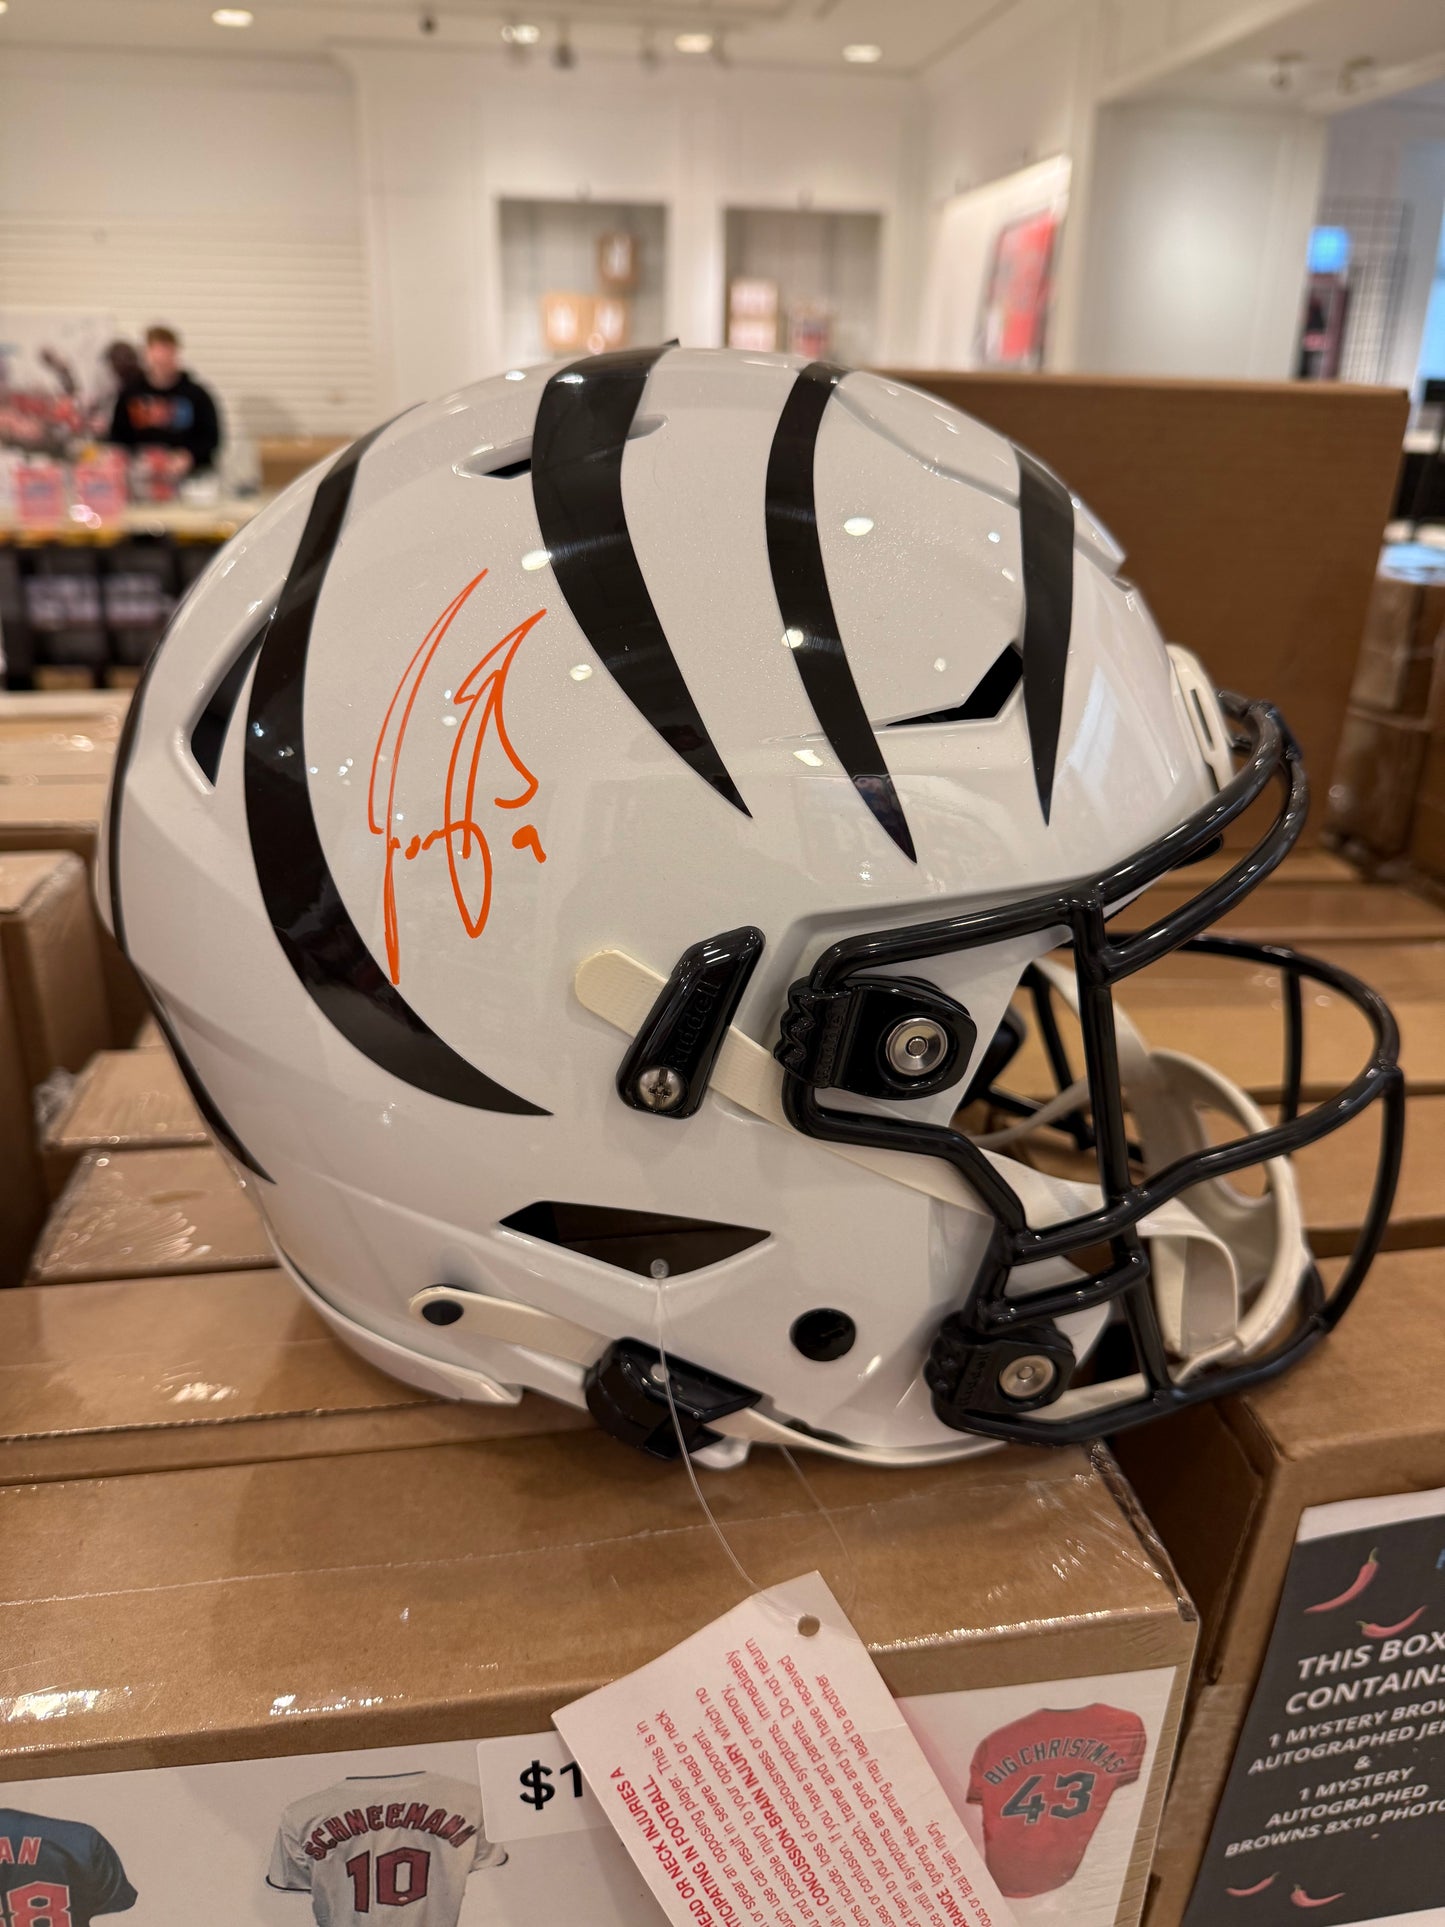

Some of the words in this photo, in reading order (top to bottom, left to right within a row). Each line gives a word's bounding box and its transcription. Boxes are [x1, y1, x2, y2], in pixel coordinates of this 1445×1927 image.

[745, 1638, 771, 1676] return
[1298, 1644, 1373, 1682] THIS
[1378, 1631, 1445, 1663] BOX
[695, 1687, 711, 1705] no
[726, 1649, 771, 1721] immediately
[764, 1674, 783, 1698] not
[777, 1655, 814, 1707] received
[815, 1674, 847, 1719] another
[704, 1704, 731, 1741] which
[721, 1684, 754, 1736] memory,
[778, 1697, 795, 1719] Do
[809, 1706, 831, 1738] have
[636, 1720, 650, 1736] in
[644, 1733, 657, 1747] is
[655, 1709, 680, 1740] neck
[791, 1716, 825, 1764] parents.
[842, 1719, 855, 1735] to
[1269, 1733, 1281, 1748] 1
[1286, 1710, 1388, 1745] MYSTERY
[673, 1740, 688, 1755] or
[692, 1726, 733, 1785] opponent.
[748, 1737, 763, 1750] or
[768, 1720, 808, 1783] symptoms,
[826, 1736, 848, 1759] you
[847, 1733, 869, 1760] lead
[1248, 1726, 1415, 1775] AUTOGRAPHED
[609, 1766, 625, 1779] A
[651, 1746, 672, 1776] This
[679, 1754, 706, 1788] head
[723, 1742, 760, 1790] INJURY
[813, 1762, 836, 1786] and
[836, 1758, 858, 1781] and
[865, 1758, 884, 1784] may
[983, 1756, 1019, 1785] BIG
[1018, 1737, 1125, 1775] CHRISTMAS
[1354, 1755, 1372, 1771] &
[667, 1772, 700, 1812] player.
[726, 1785, 752, 1812] your
[758, 1749, 811, 1830] consciousness
[802, 1782, 824, 1813] have
[852, 1780, 877, 1810] gone
[1001, 1770, 1096, 1825] 43
[1299, 1788, 1310, 1801] 1
[1315, 1766, 1415, 1798] MYSTERY
[616, 1779, 661, 1842] INJURIES
[642, 1774, 691, 1848] FOOTBALL.
[700, 1784, 729, 1823] severe
[742, 1810, 756, 1826] to
[829, 1786, 856, 1823] trainer
[868, 1809, 886, 1829] are
[878, 1781, 908, 1827] warning
[1265, 1784, 1429, 1828] AUTOGRAPHED
[304, 1802, 477, 1861] SCHNEEMANN
[690, 1809, 728, 1864] opposing
[723, 1822, 736, 1835] in
[801, 1830, 818, 1843] of
[819, 1809, 841, 1833] you
[925, 1820, 947, 1851] injury.
[1225, 1824, 1321, 1857] BROWNS
[1324, 1814, 1377, 1834] 8X10
[728, 1833, 755, 1867] result
[750, 1824, 775, 1858] injury
[750, 1786, 830, 1907] CONCUSSION-BRAIN
[827, 1832, 843, 1844] If
[851, 1820, 877, 1858] coach,
[903, 1826, 920, 1848] this
[652, 1838, 684, 1880] NECK
[681, 1844, 700, 1864] IN
[812, 1842, 832, 1868] loss
[838, 1841, 874, 1894] confusion.
[871, 1857, 894, 1882] your
[879, 1828, 916, 1881] symptoms
[914, 1844, 945, 1888] Ignoring
[941, 1850, 962, 1878] brain
[345, 1846, 431, 1913] 10
[722, 1863, 738, 1880] an
[749, 1865, 768, 1888] can
[769, 1854, 805, 1900] possible
[826, 1865, 856, 1906] include:
[906, 1879, 923, 1893] all
[953, 1874, 974, 1899] fatal
[675, 1876, 696, 1900] OR
[731, 1880, 757, 1911] spear
[762, 1887, 781, 1909] use
[867, 1894, 881, 1906] or
[885, 1880, 898, 1895] to
[914, 1891, 935, 1914] until
[967, 1897, 981, 1909] or
[0, 1881, 72, 1927] 8
[749, 1910, 764, 1923] or
[792, 1898, 815, 1920] and
[825, 1904, 838, 1917] in
[892, 1892, 913, 1919] them
